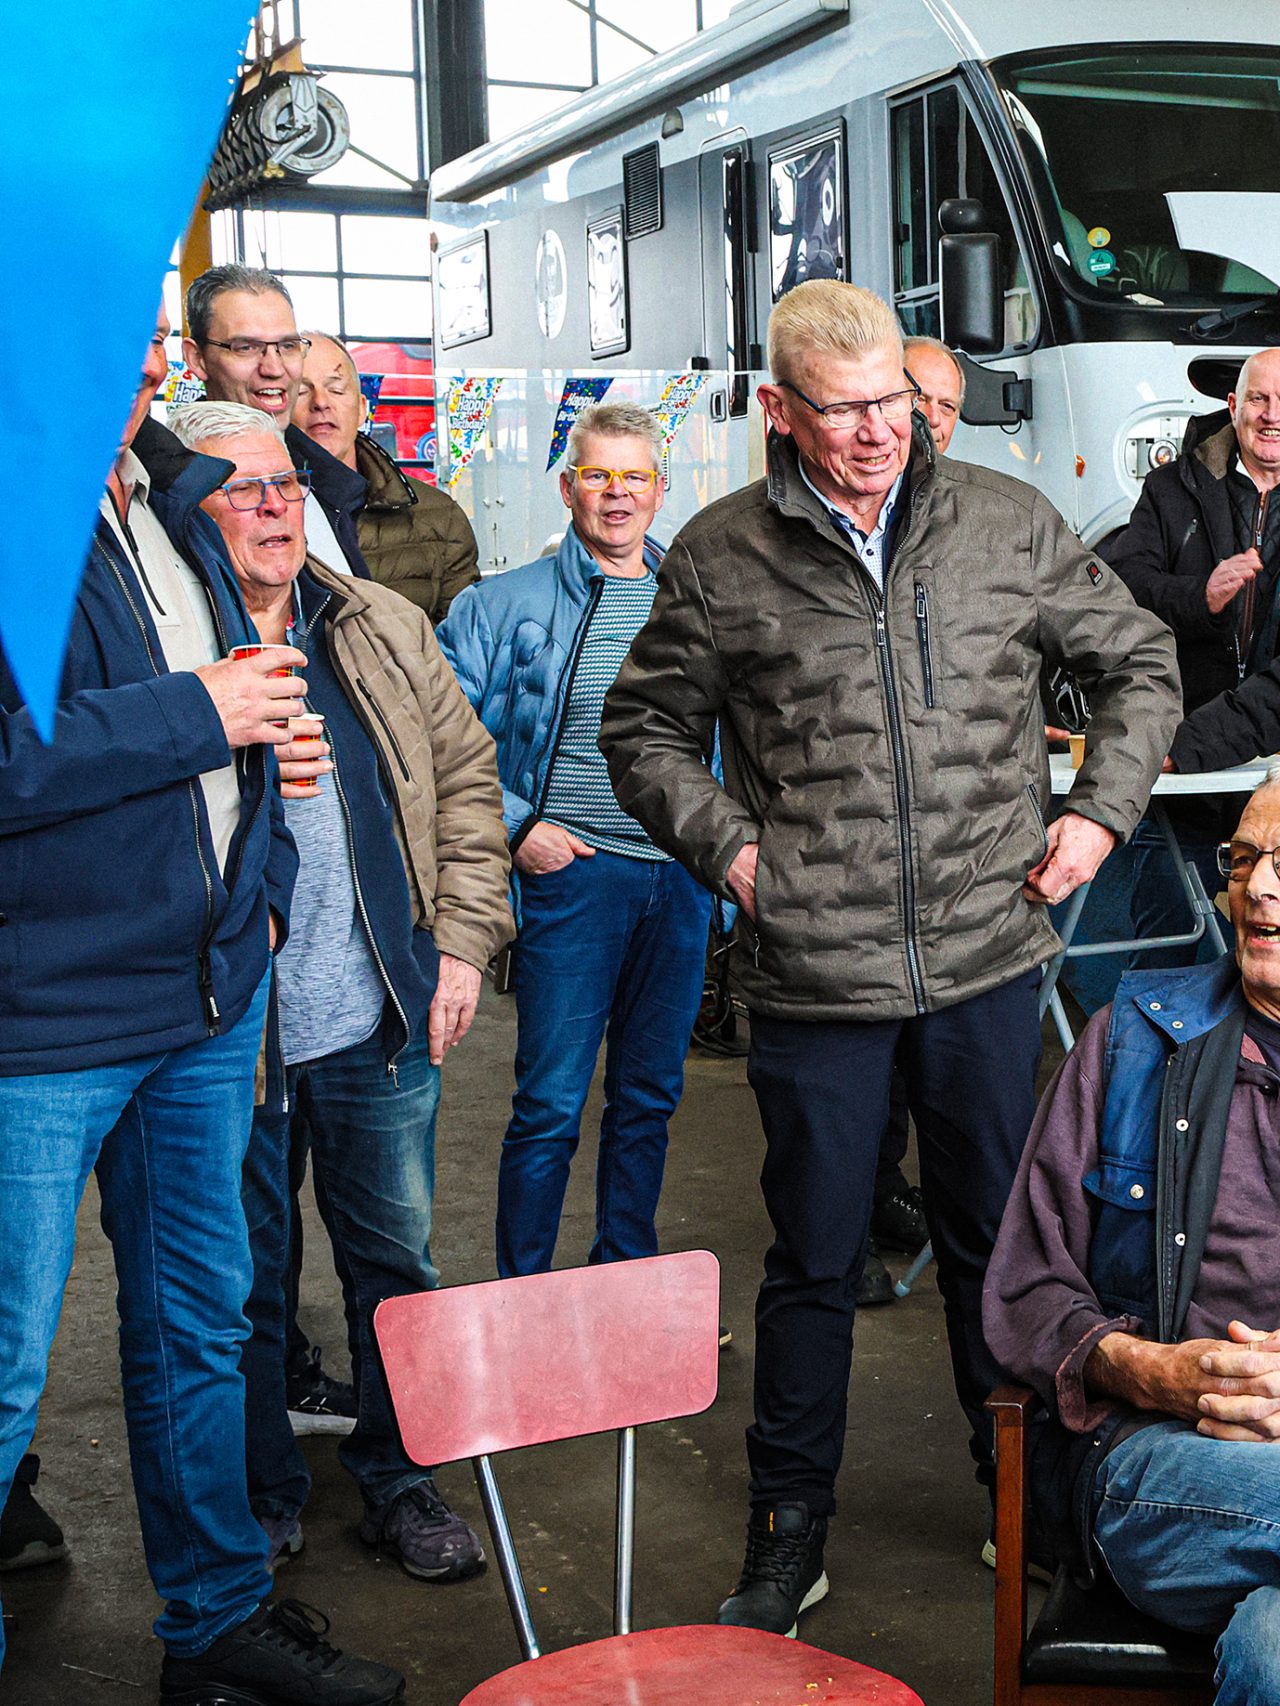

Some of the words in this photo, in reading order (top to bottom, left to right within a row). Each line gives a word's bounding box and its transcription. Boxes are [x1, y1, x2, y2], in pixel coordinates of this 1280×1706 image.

[173, 381, 207, 402] Hap
[565, 392, 597, 411] Happy
[457, 395, 487, 416] Happy
